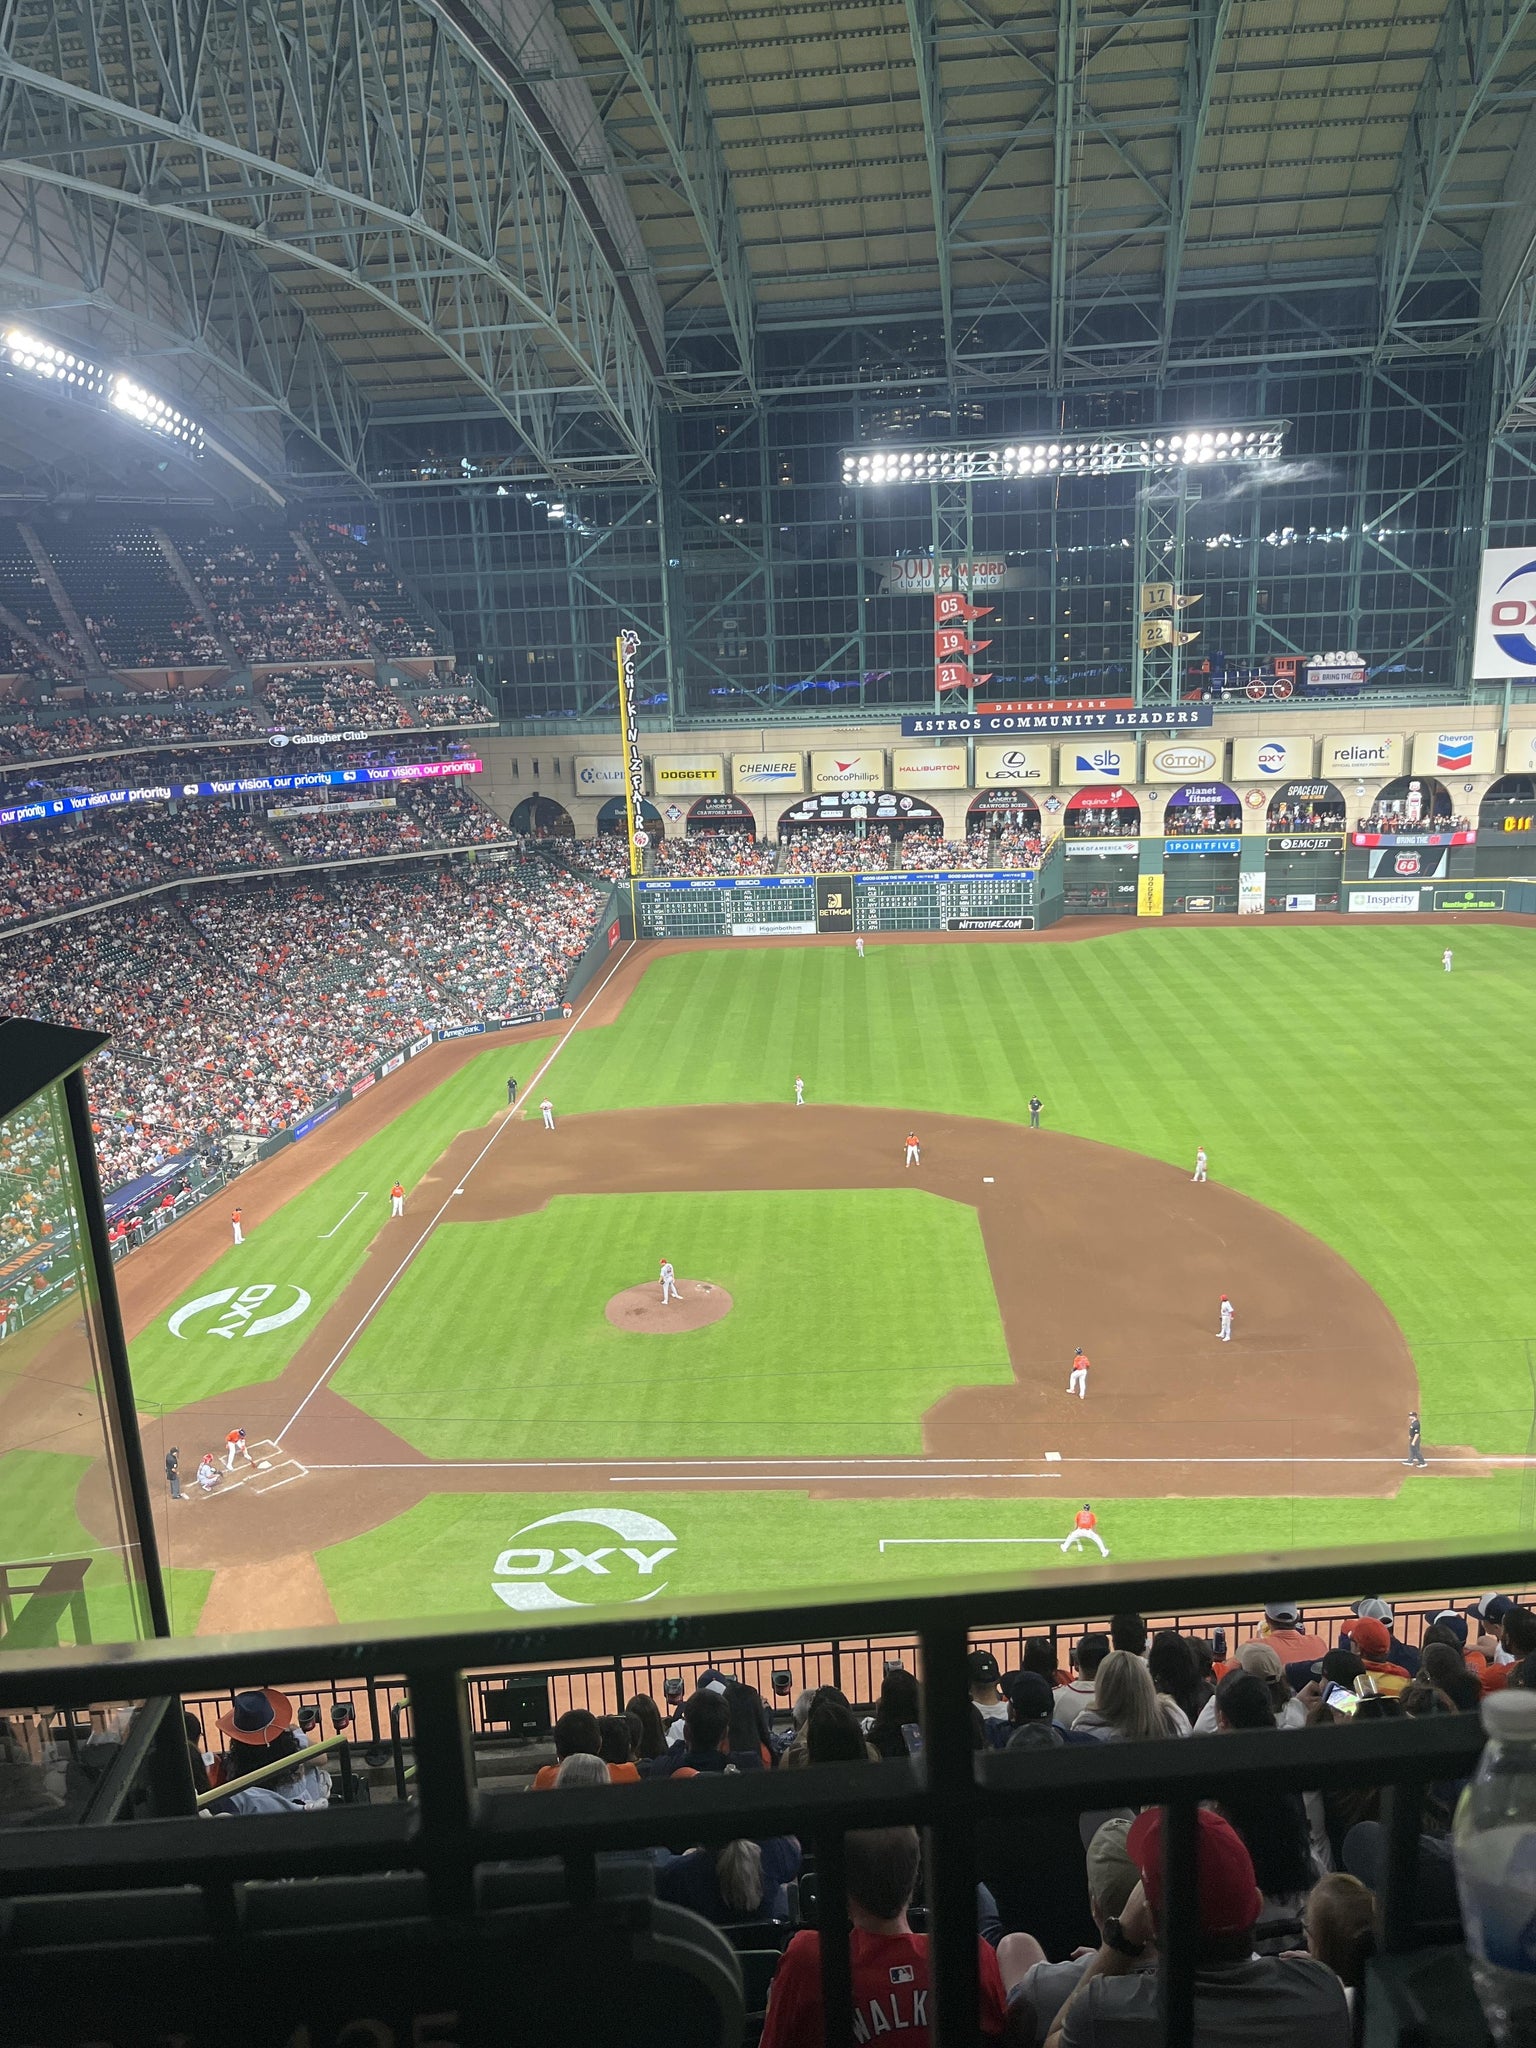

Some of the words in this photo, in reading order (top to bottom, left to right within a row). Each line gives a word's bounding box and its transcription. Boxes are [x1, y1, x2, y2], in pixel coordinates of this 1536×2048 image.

[900, 578, 948, 588] LUXUY
[1149, 589, 1165, 603] 17
[941, 598, 958, 613] 05
[1147, 628, 1163, 640] 22
[942, 635, 958, 648] 19
[942, 669, 957, 682] 21
[1352, 672, 1361, 680] GO
[624, 660, 639, 743] CHIKIN
[996, 702, 1054, 711] DAIKIN
[1067, 700, 1106, 709] PARK
[914, 718, 981, 731] ASTROS
[990, 714, 1106, 728] COMMUNITY
[1116, 711, 1200, 724] LEADERS
[292, 732, 342, 745] Gallagher
[343, 731, 368, 741] Club
[1094, 750, 1120, 766] slb
[1258, 753, 1285, 762] OXY
[1334, 745, 1385, 760] reliant
[1161, 754, 1205, 768] COTTON
[366, 769, 389, 778] Your
[392, 766, 422, 776] vision,
[442, 762, 475, 774] priority
[739, 763, 797, 773] CHENIERE
[596, 771, 624, 780] CALPI
[661, 770, 717, 779] DOGGETT
[816, 772, 879, 782] ConocoPhillips
[986, 770, 1040, 779] LEXUS
[210, 782, 236, 792] Your
[238, 778, 272, 790] vision,
[275, 778, 293, 786] our
[294, 773, 331, 788] priority
[1185, 787, 1216, 796] planet
[1288, 785, 1312, 796] SPACE
[1312, 785, 1328, 795] CITY
[70, 798, 86, 808] Your
[110, 790, 125, 801] our
[129, 786, 171, 802] priority
[631, 774, 644, 829] FAIR
[1082, 798, 1109, 807] equinor
[1189, 794, 1222, 803] fitness
[2, 810, 16, 821] our
[18, 806, 46, 823] priority
[1292, 839, 1331, 849] EMCJET
[1400, 861, 1414, 869] 66
[1367, 894, 1414, 906] Insperity
[959, 920, 1022, 929] NITTOTIRE.COM
[206, 1284, 277, 1339] OXY
[493, 1548, 678, 1575] OXY
[852, 1990, 928, 2044] WALK
